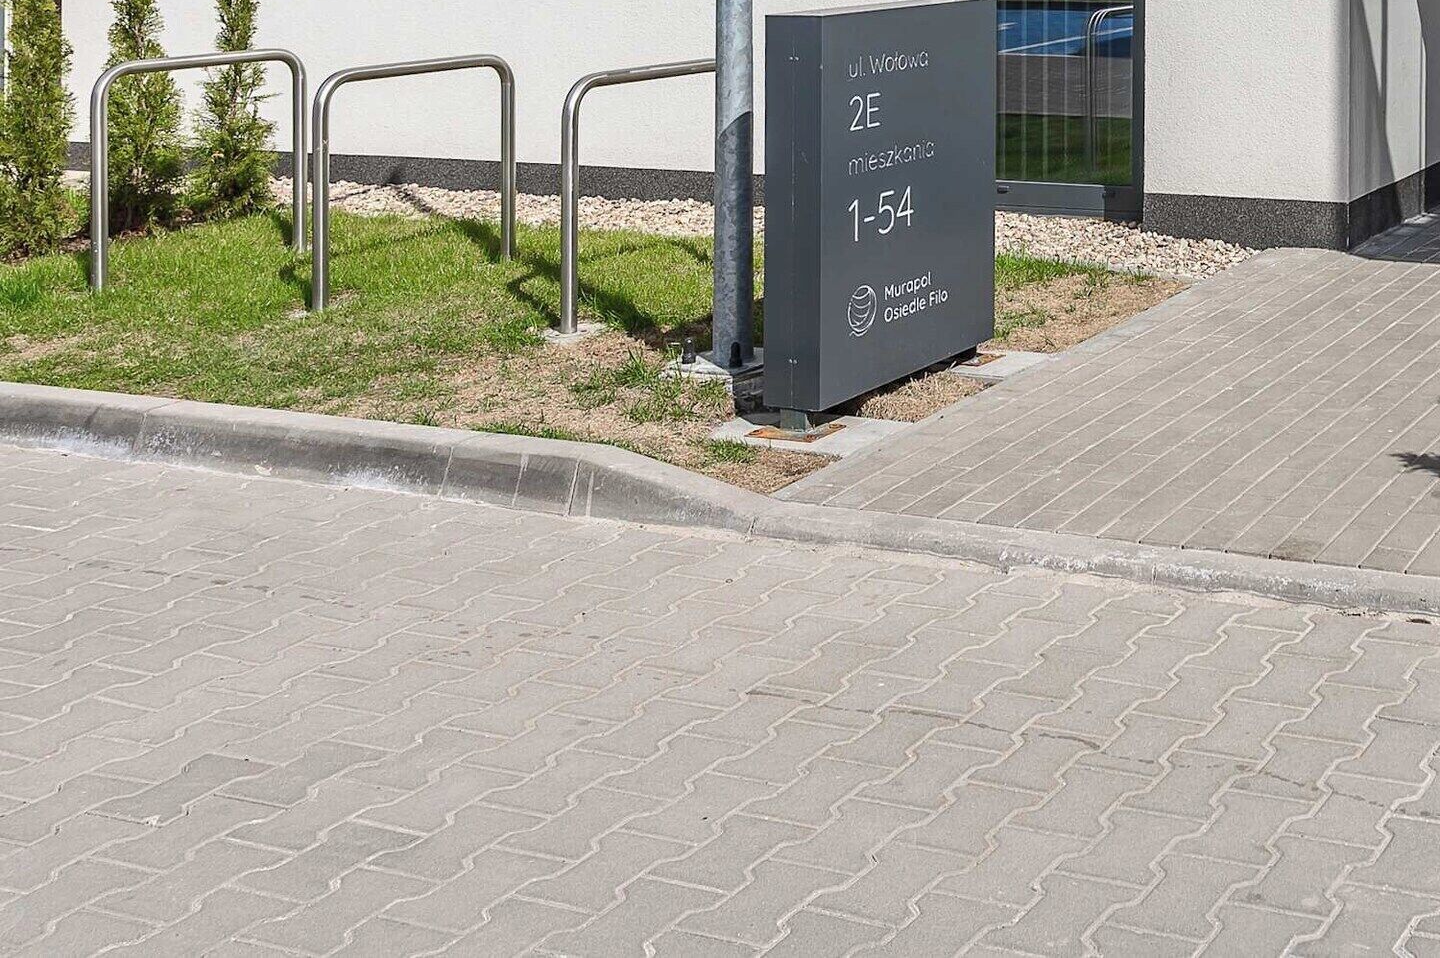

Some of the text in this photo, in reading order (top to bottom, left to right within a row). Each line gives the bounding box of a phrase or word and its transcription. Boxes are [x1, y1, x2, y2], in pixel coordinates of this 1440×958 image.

[849, 51, 929, 78] ul. Wołowa
[849, 92, 881, 131] 2E
[848, 140, 935, 176] mieszkania
[848, 185, 914, 242] 1-54
[884, 271, 931, 300] Murapol
[884, 289, 948, 322] Osiedle Filo
